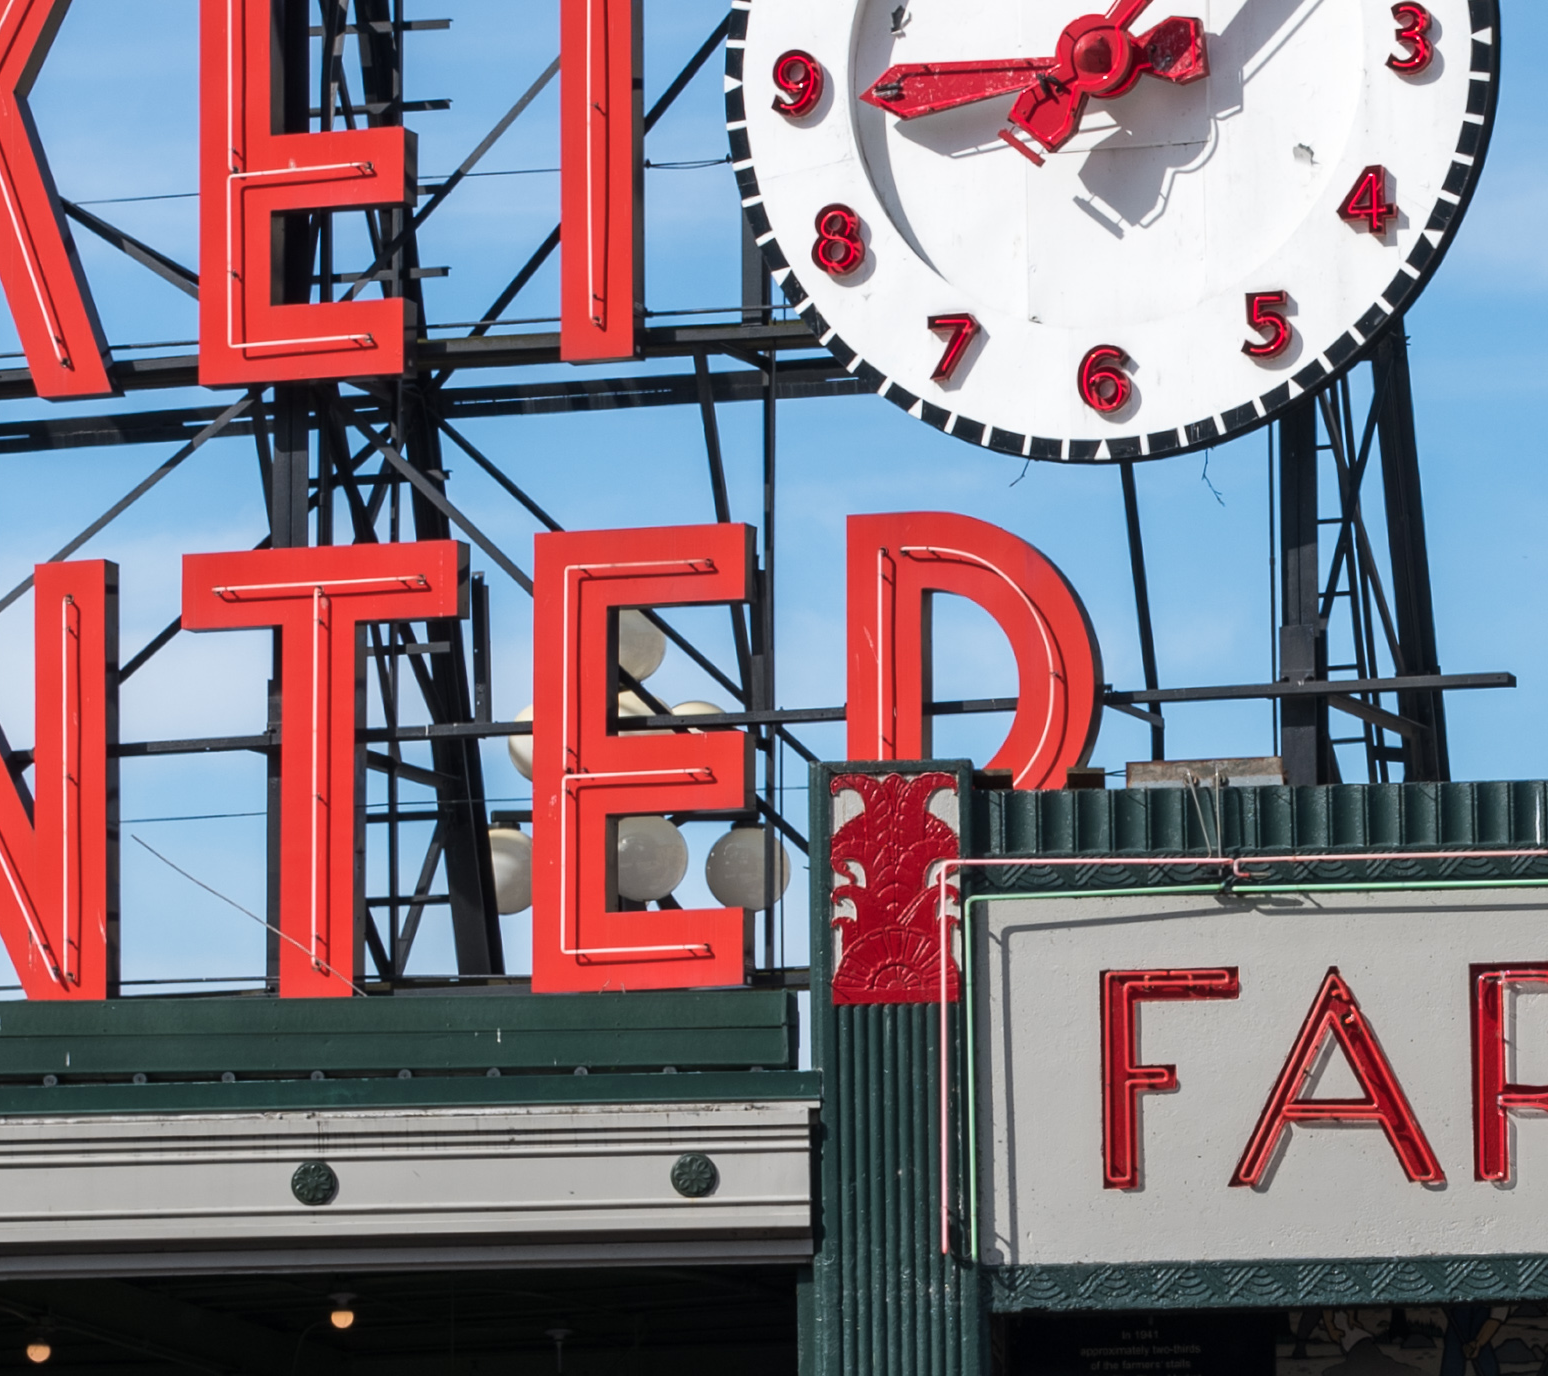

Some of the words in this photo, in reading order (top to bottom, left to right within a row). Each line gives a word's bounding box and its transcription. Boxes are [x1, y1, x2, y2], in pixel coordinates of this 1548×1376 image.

[1386, 0, 1433, 75] 3
[771, 49, 824, 119] 9
[1337, 164, 1398, 236] 4
[812, 203, 865, 276] 8
[927, 312, 980, 383] 7
[1240, 289, 1294, 362] 5
[1078, 343, 1132, 416] 6
[1079, 1345, 1150, 1357] approximately
[1152, 1343, 1202, 1355] two-thirds
